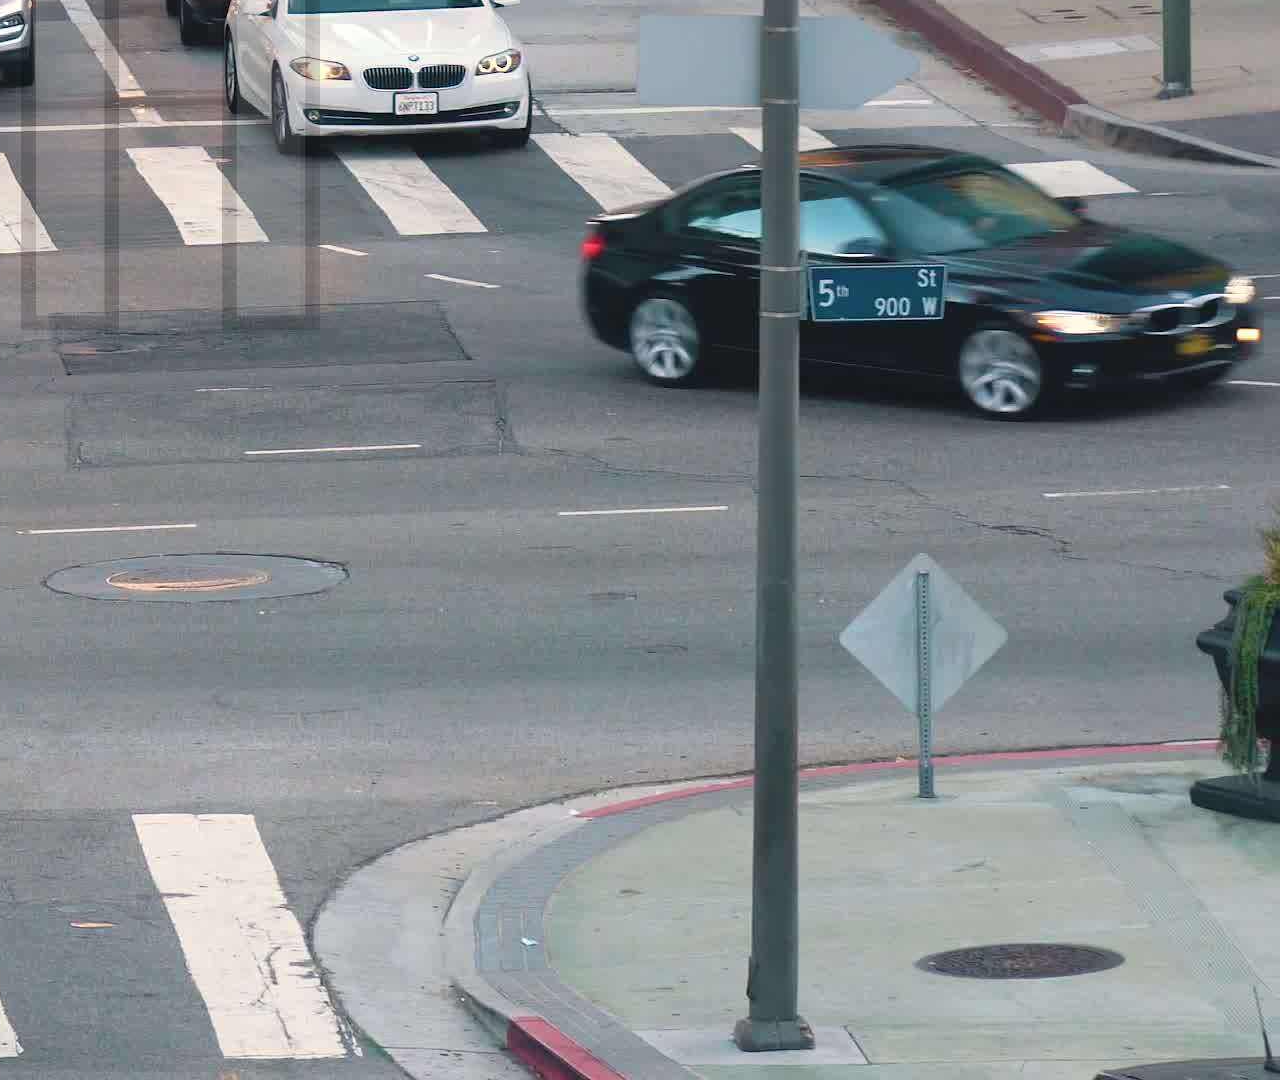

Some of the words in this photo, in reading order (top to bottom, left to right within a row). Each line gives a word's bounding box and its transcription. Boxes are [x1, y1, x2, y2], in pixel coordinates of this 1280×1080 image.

[818, 279, 849, 308] 5th
[917, 268, 937, 288] St
[874, 297, 911, 317] 900
[921, 296, 938, 316] W
